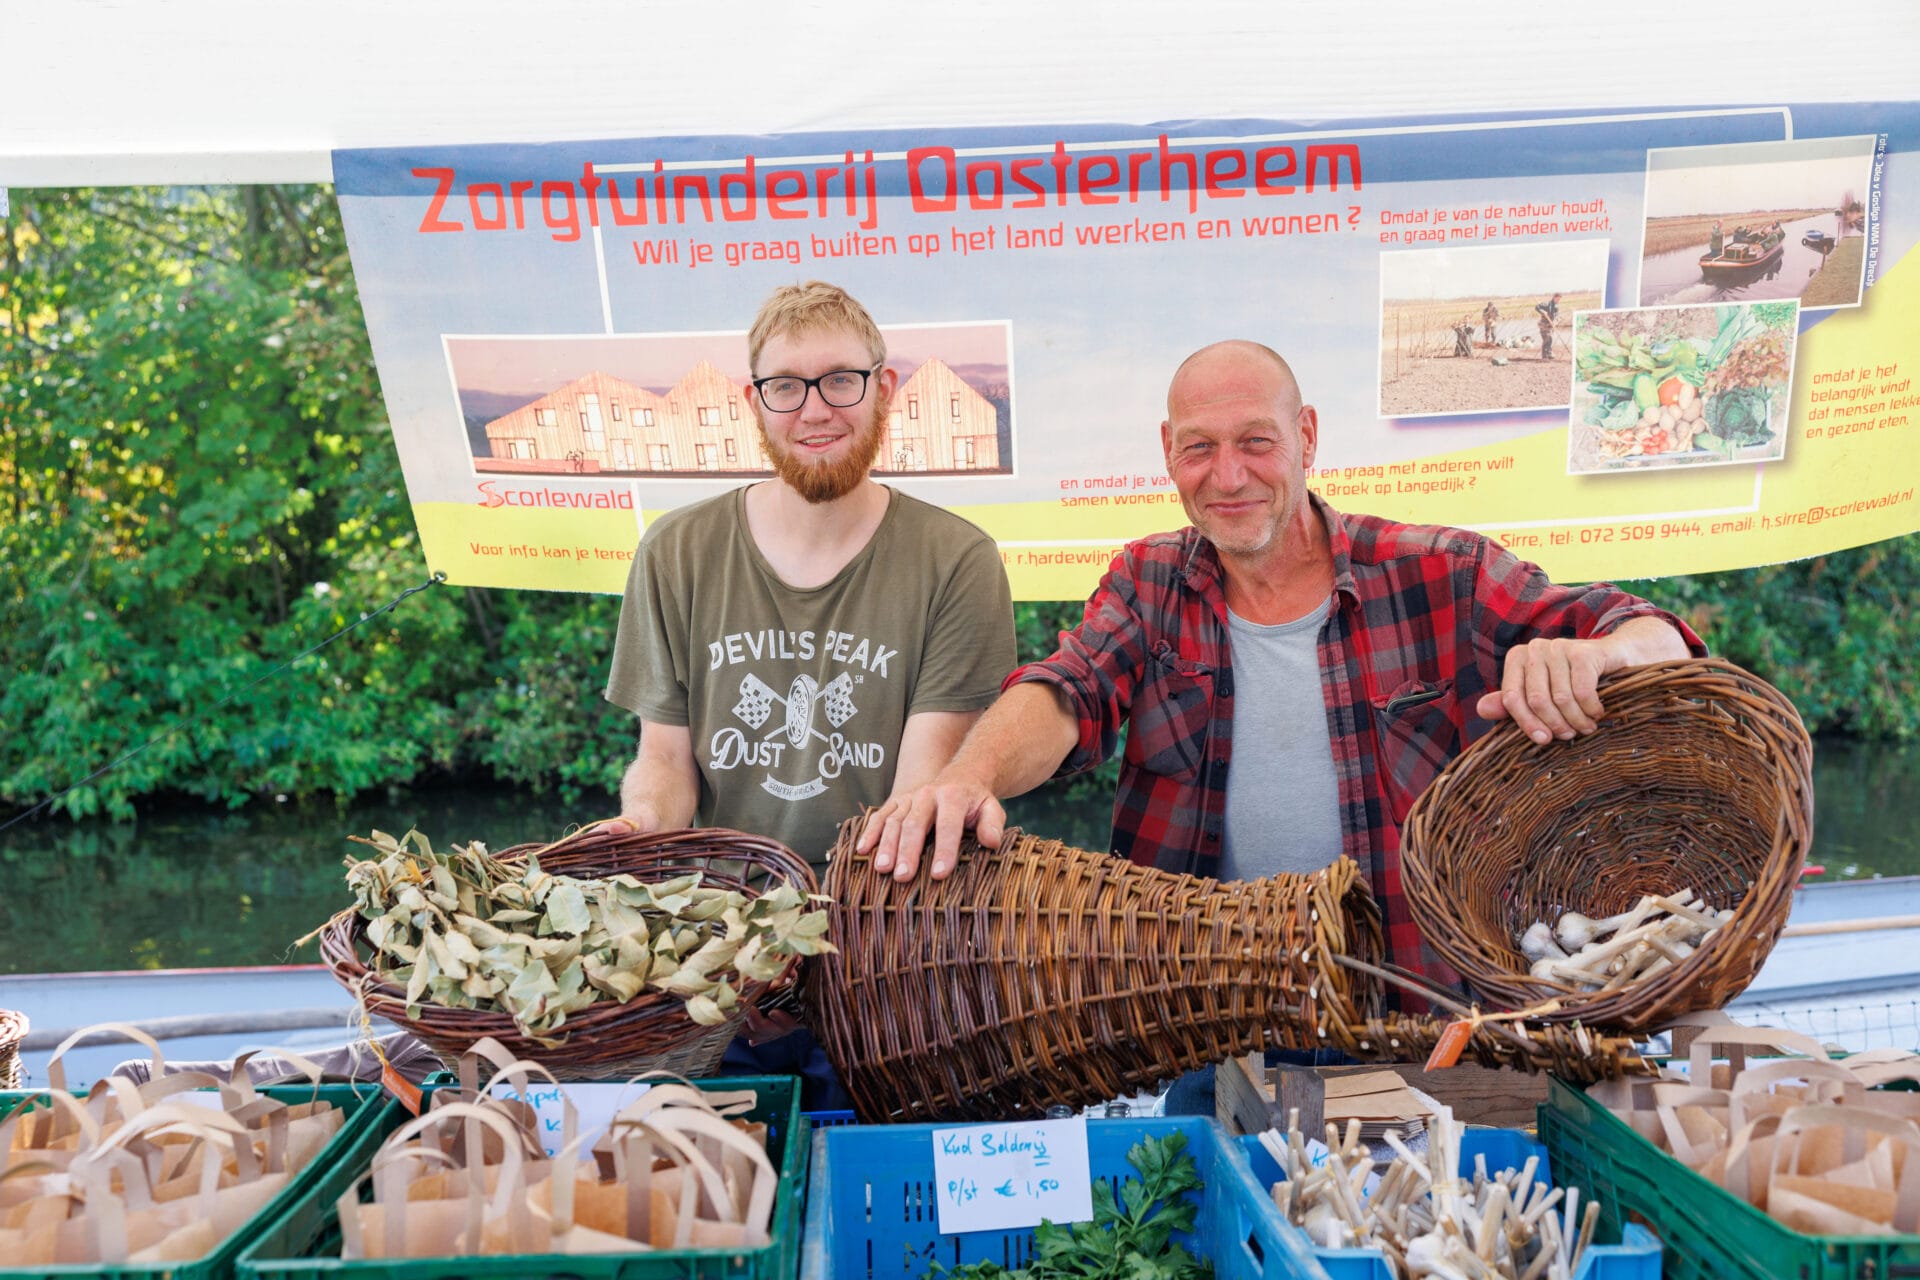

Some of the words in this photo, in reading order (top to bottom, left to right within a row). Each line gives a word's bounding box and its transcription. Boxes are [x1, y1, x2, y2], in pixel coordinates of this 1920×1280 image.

[411, 149, 878, 242] Zorgtuinderij
[906, 134, 1362, 213] Oosterheem
[1380, 209, 1429, 226] Omdat
[1432, 208, 1447, 225] je
[1453, 208, 1479, 221] van
[1484, 205, 1504, 220] de
[1508, 202, 1556, 218] natuur
[633, 239, 679, 265] Wil
[689, 239, 714, 268] je
[725, 239, 801, 267] graag
[811, 231, 897, 258] buiten
[908, 233, 940, 258] op
[951, 225, 996, 256] het
[1006, 220, 1064, 249] land
[1075, 217, 1186, 246] werken
[1197, 219, 1231, 240] en
[1242, 213, 1339, 237] wonen
[1347, 206, 1362, 231] ?
[1379, 230, 1399, 243] en
[1404, 227, 1445, 245] graag
[1450, 224, 1479, 240] met
[1483, 224, 1497, 240] je
[1503, 219, 1559, 237] handen
[1813, 368, 1855, 385] omdat
[1858, 366, 1871, 383] je
[1875, 362, 1898, 380] het
[1811, 383, 1876, 403] belangrijk
[1880, 378, 1911, 395] vindt
[1808, 405, 1830, 421] dat
[1833, 401, 1886, 418] mensen
[1806, 427, 1823, 439] en
[1827, 418, 1875, 438] gezond
[1321, 468, 1339, 479] en
[1344, 465, 1384, 480] graag
[1389, 461, 1416, 475] met
[1421, 458, 1481, 474] anderen
[1487, 456, 1514, 470] wilt
[1060, 479, 1079, 489] en
[1084, 475, 1128, 489] omdat
[1132, 474, 1145, 489] je
[1327, 482, 1369, 497] Broek
[1375, 482, 1392, 496] op
[1397, 477, 1465, 494] Langedijk
[478, 480, 634, 510] Scorlewald
[1061, 495, 1109, 507] samen
[1114, 493, 1165, 505] wonen
[1500, 533, 1543, 548] Sirre,
[1550, 530, 1574, 546] tel:
[1580, 528, 1614, 544] 072
[1620, 525, 1654, 541] 509
[1711, 516, 1755, 535] email:
[1761, 488, 1914, 531] h.sirre@scorlewald.nl
[470, 542, 503, 556] Voor
[509, 544, 538, 559] info
[543, 544, 571, 558] kan
[575, 546, 590, 561] je
[595, 547, 637, 561] terec
[708, 629, 815, 671] DEVIL'S
[824, 630, 898, 679] PEAK
